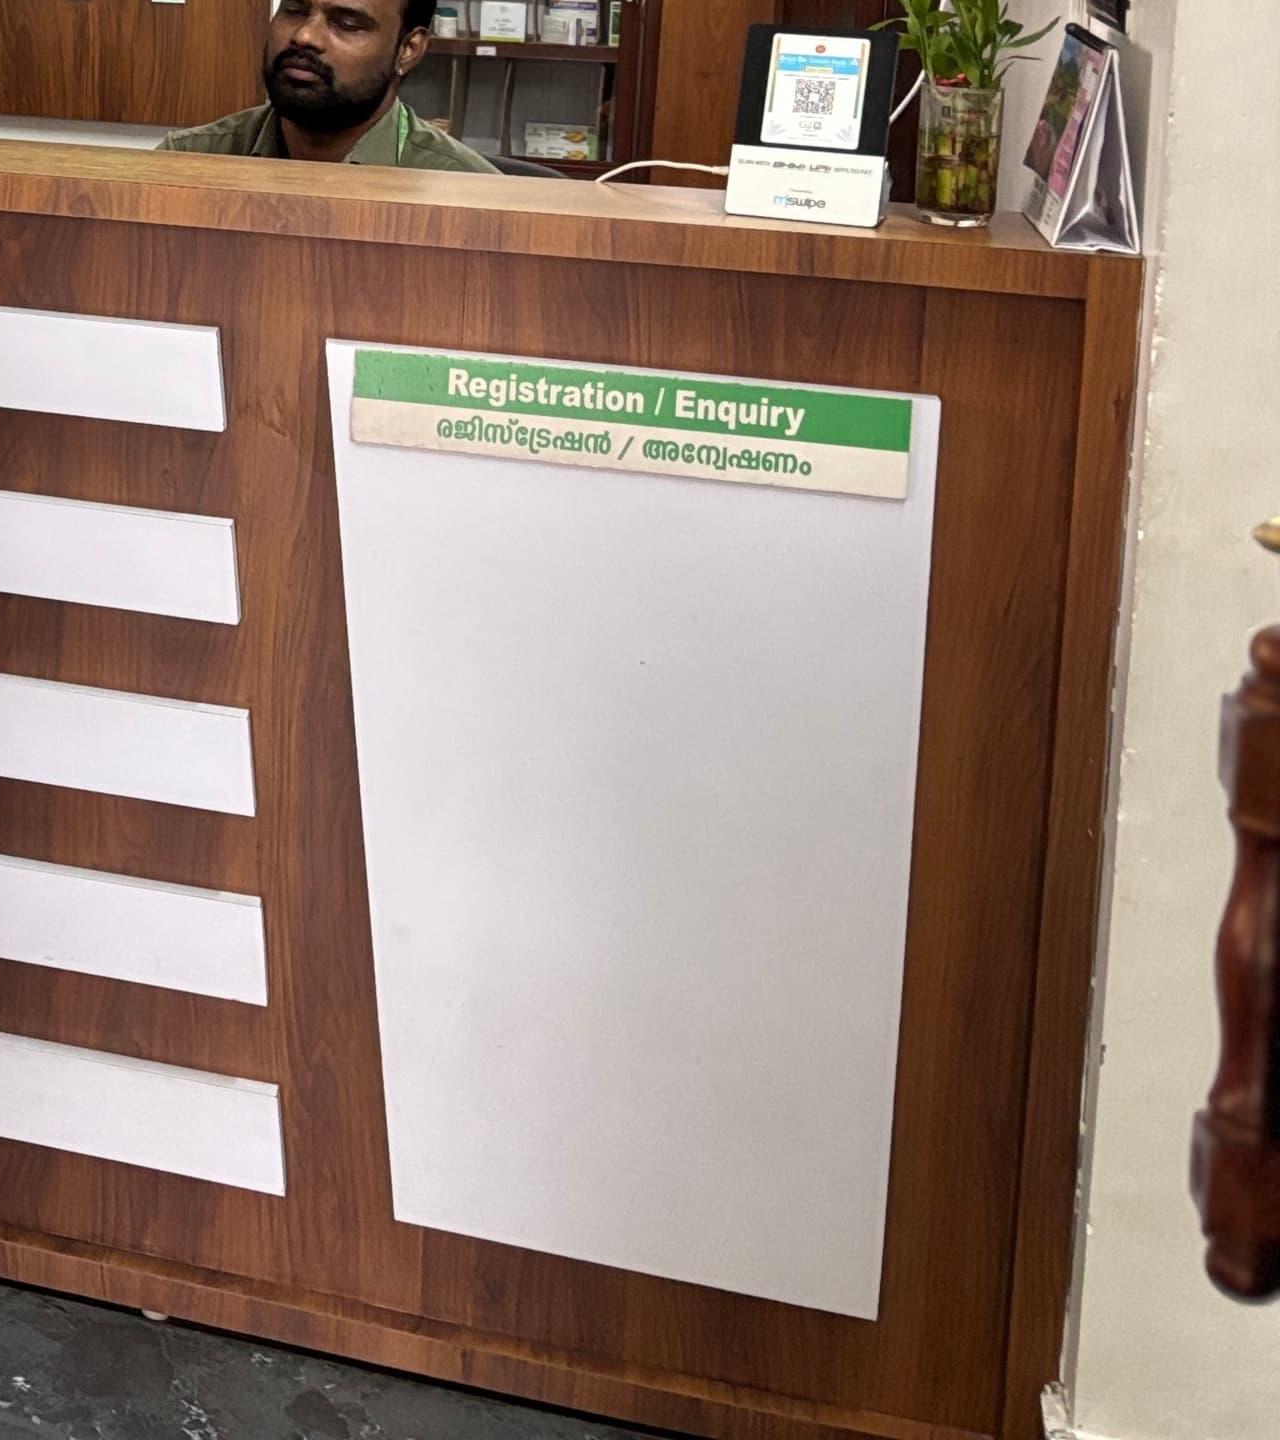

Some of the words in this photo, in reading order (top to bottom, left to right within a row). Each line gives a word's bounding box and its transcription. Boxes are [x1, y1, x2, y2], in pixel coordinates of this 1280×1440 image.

[448, 368, 644, 414] Registration
[654, 388, 665, 416] /
[674, 390, 806, 436] Enquiry
[436, 414, 611, 455] രജിസ്ട്രേഷൻ
[618, 436, 634, 460] /
[642, 439, 813, 476] അന്വേഷണം
